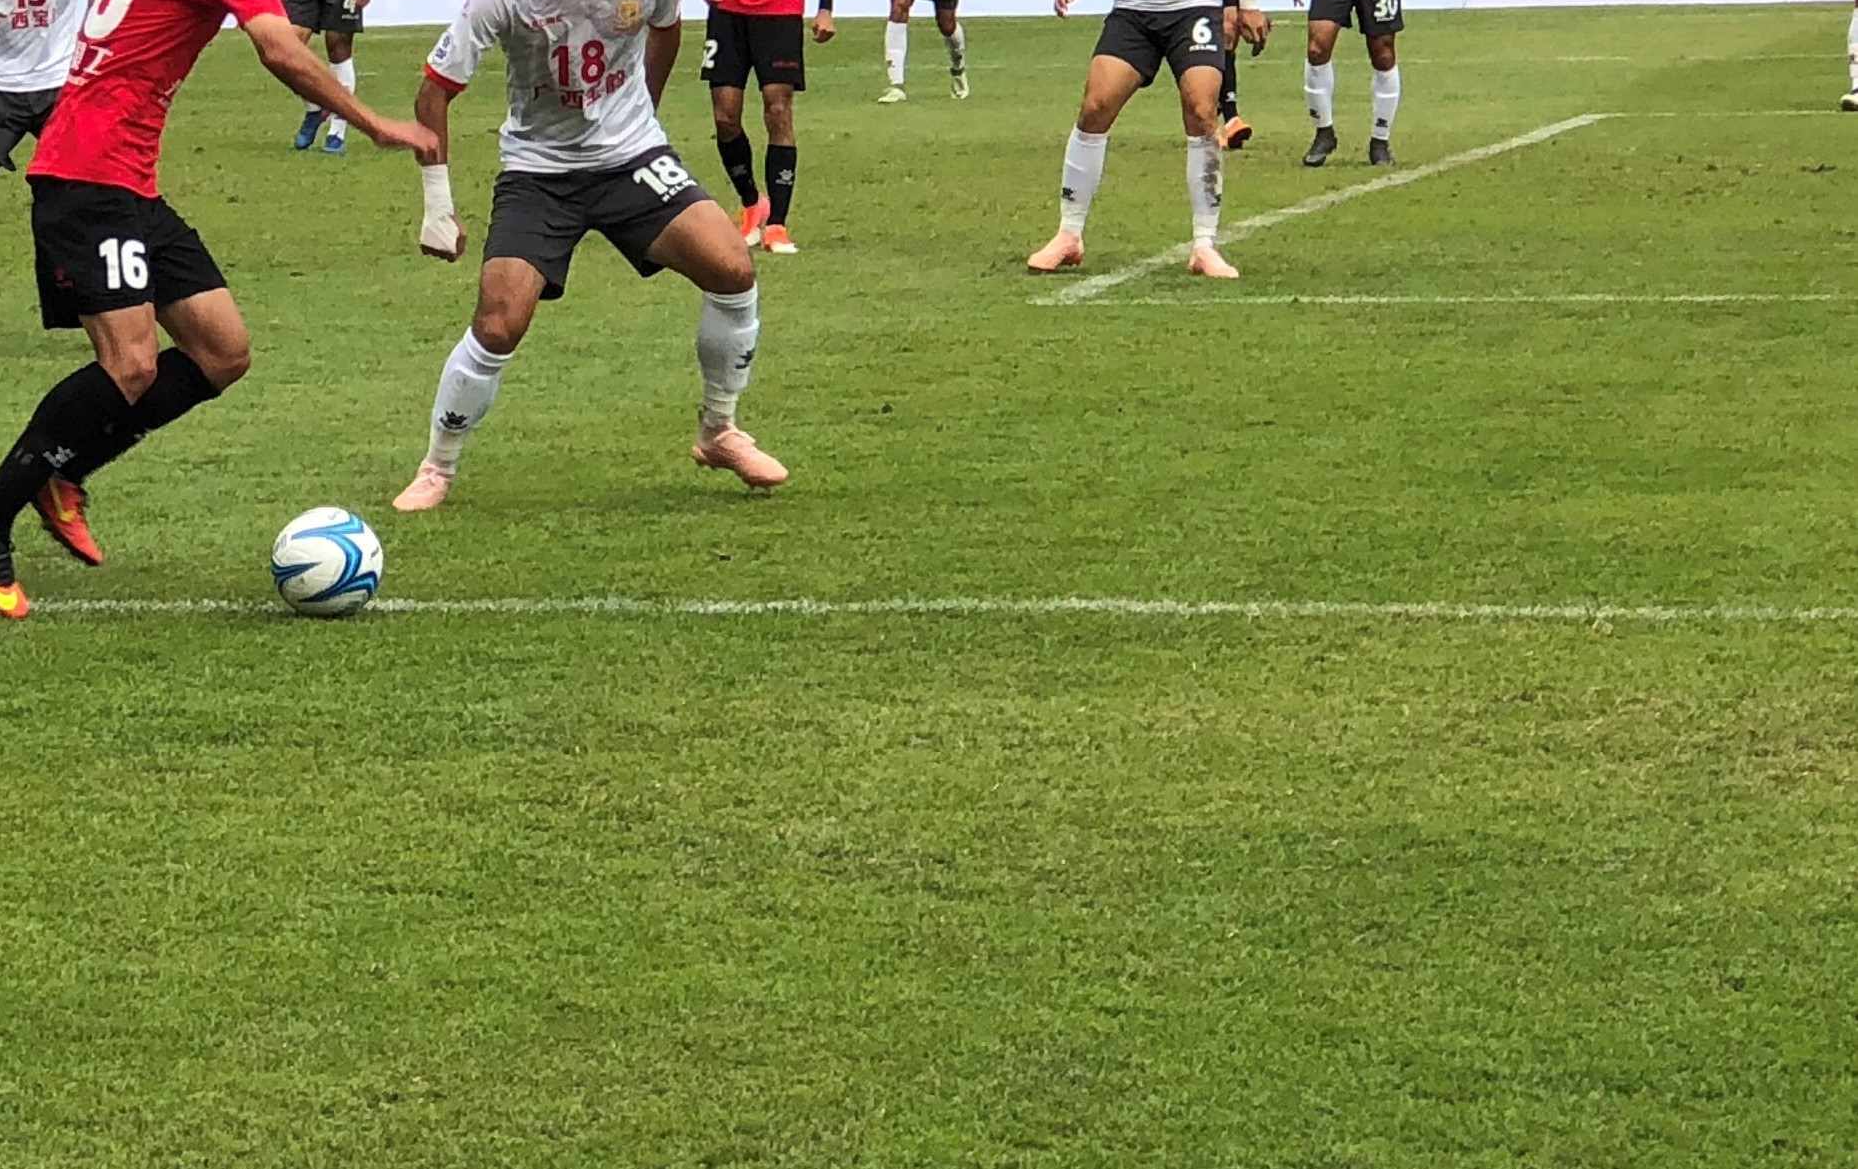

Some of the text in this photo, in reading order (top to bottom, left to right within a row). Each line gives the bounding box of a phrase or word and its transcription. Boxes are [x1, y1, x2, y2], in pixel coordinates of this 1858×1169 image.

[1192, 17, 1212, 44] 6
[551, 39, 606, 88] 18
[702, 39, 718, 69] 2
[632, 154, 689, 195] 18
[98, 237, 149, 290] 16
